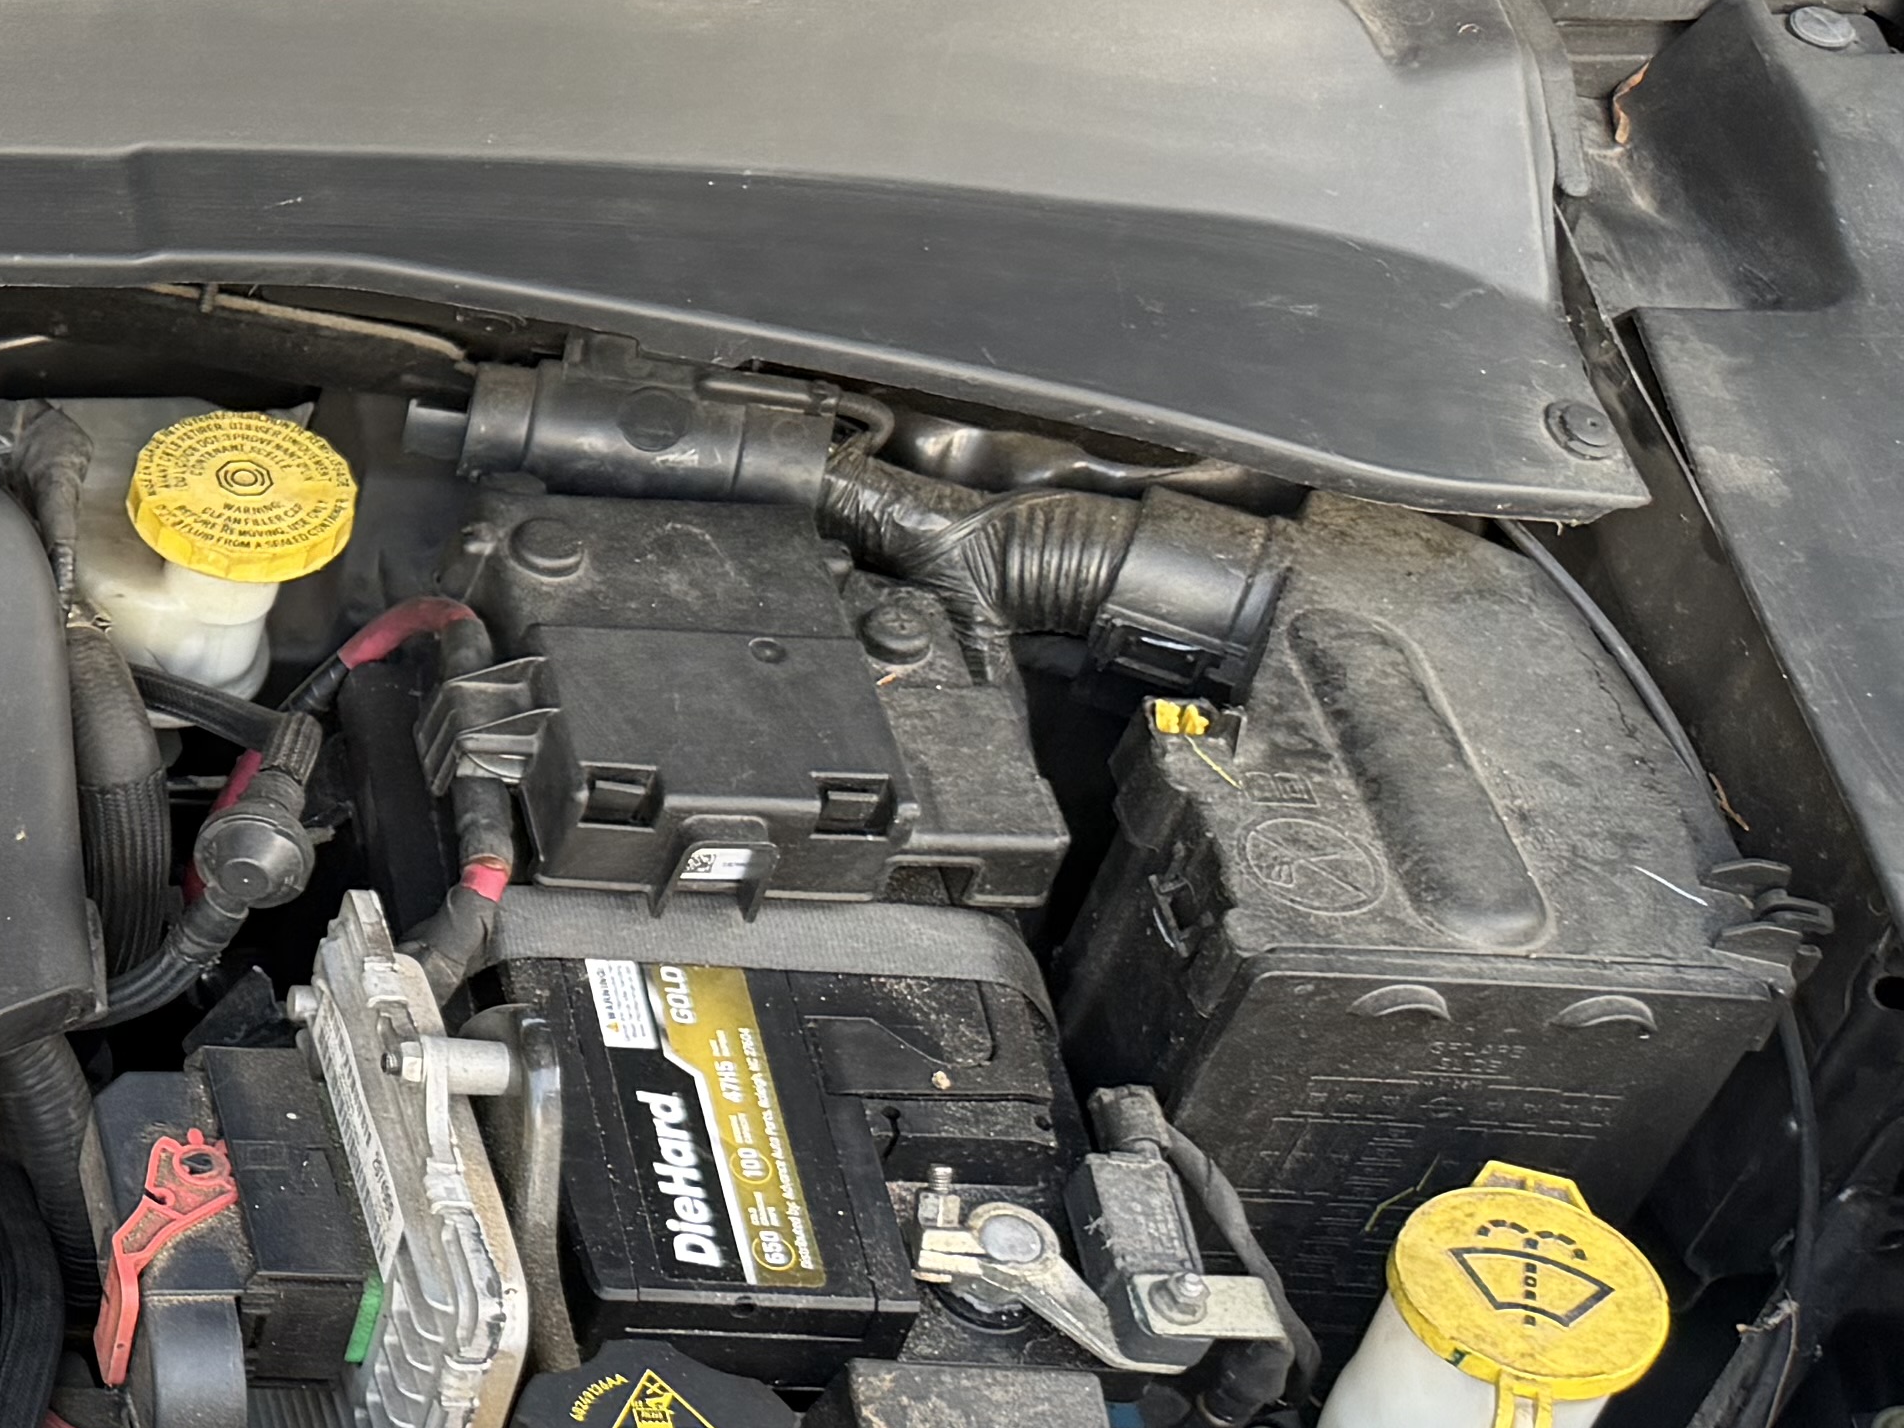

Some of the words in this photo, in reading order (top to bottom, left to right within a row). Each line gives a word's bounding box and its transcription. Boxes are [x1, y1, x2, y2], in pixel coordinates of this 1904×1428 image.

[659, 965, 697, 1025] GOLD
[635, 1089, 726, 1268] DieHard
[739, 1147, 764, 1178] 100
[758, 1230, 786, 1266] 650
